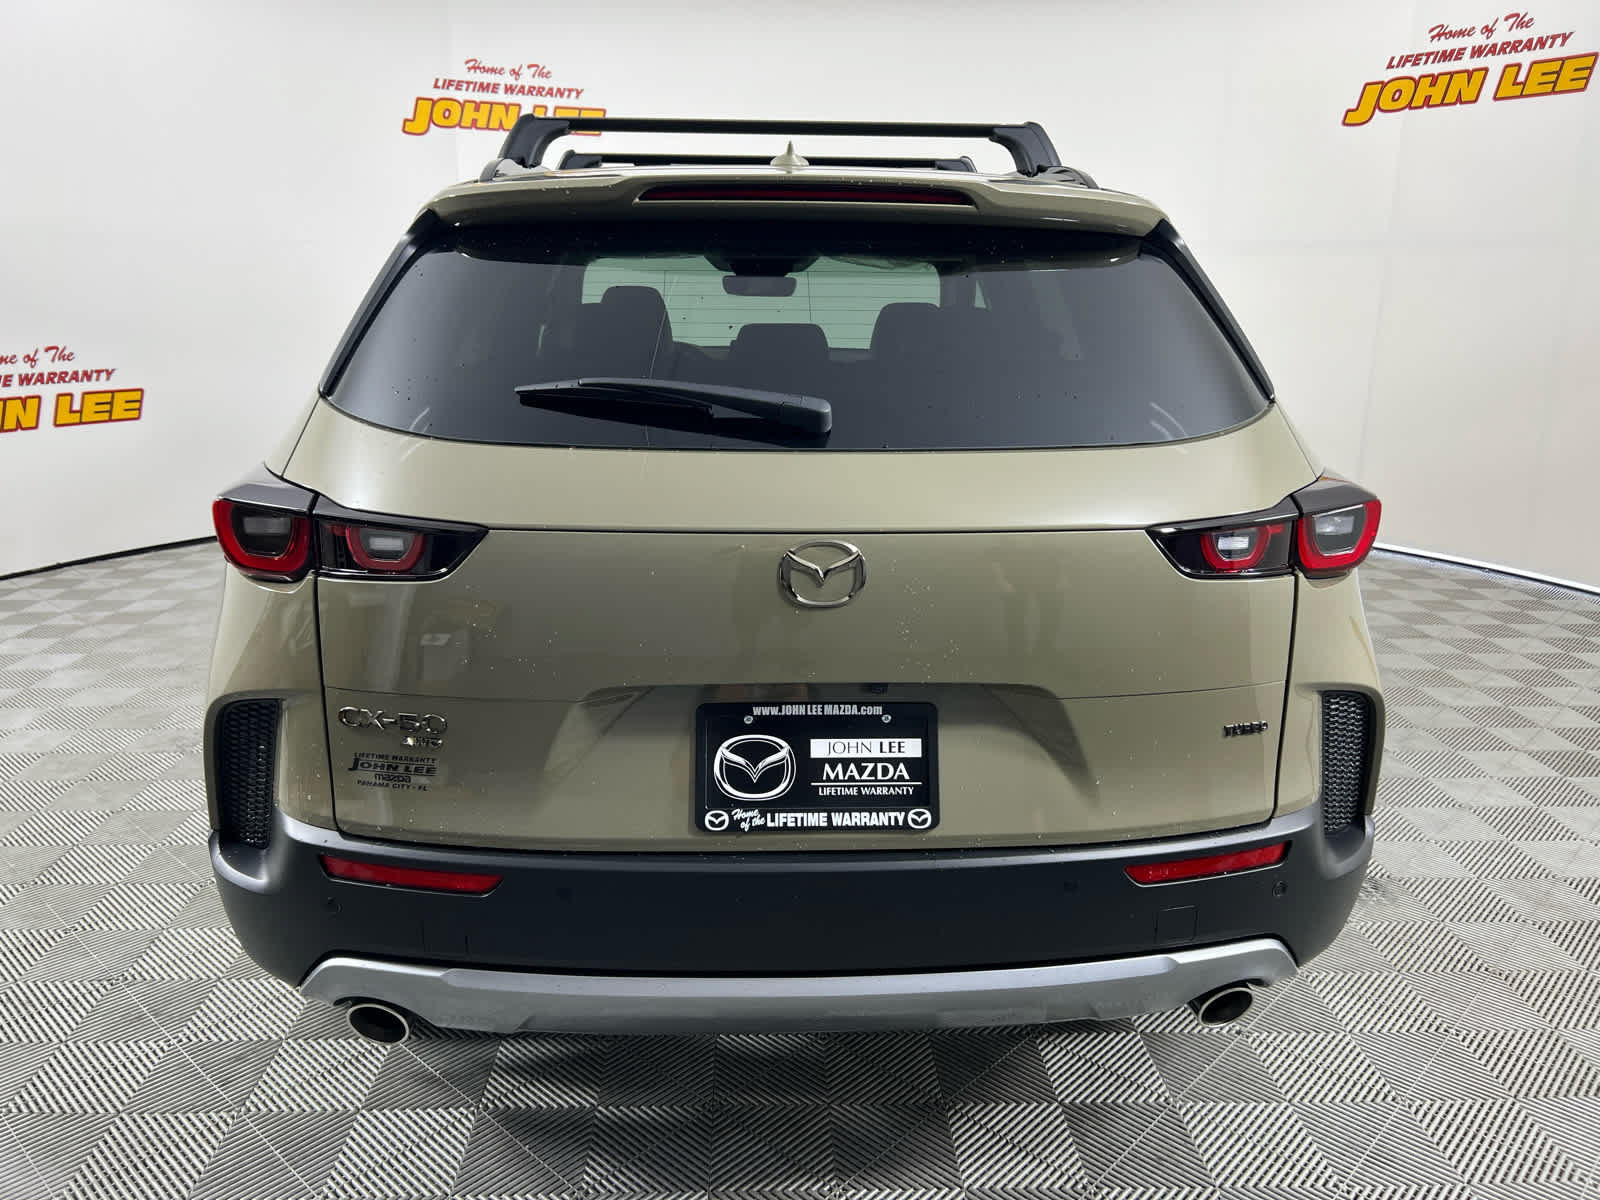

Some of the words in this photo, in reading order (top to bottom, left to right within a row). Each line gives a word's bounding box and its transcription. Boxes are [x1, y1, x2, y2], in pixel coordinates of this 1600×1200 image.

[1428, 23, 1476, 43] Home
[1480, 17, 1499, 40] of
[1504, 11, 1535, 31] The
[1386, 48, 1466, 70] LIFETIME
[1470, 31, 1575, 60] WARRANTY
[464, 58, 505, 75] Home
[509, 66, 522, 81] of
[526, 63, 553, 79] The
[433, 78, 500, 95] LIFETIME
[504, 83, 584, 100] WARRANTY
[1342, 67, 1489, 127] JOHN
[1493, 52, 1599, 101] LEE
[402, 97, 521, 136] JOHN
[23, 348, 39, 368] of
[44, 345, 75, 363] The
[18, 368, 116, 386] WARRANTY
[53, 388, 144, 427] LEE
[338, 706, 448, 734] CX-50
[826, 741, 873, 756] JOHN
[879, 741, 906, 754] LEE
[348, 757, 399, 772] JOHN
[404, 765, 437, 775] LEE
[822, 762, 910, 781] MAZDA
[392, 783, 411, 791] CITY
[818, 786, 860, 796] LIFETIME
[861, 786, 914, 796] WARRANTY
[731, 808, 759, 821] Home
[740, 816, 751, 832] of
[766, 812, 828, 828] LIFETIME
[832, 811, 906, 827] WARRANTY
